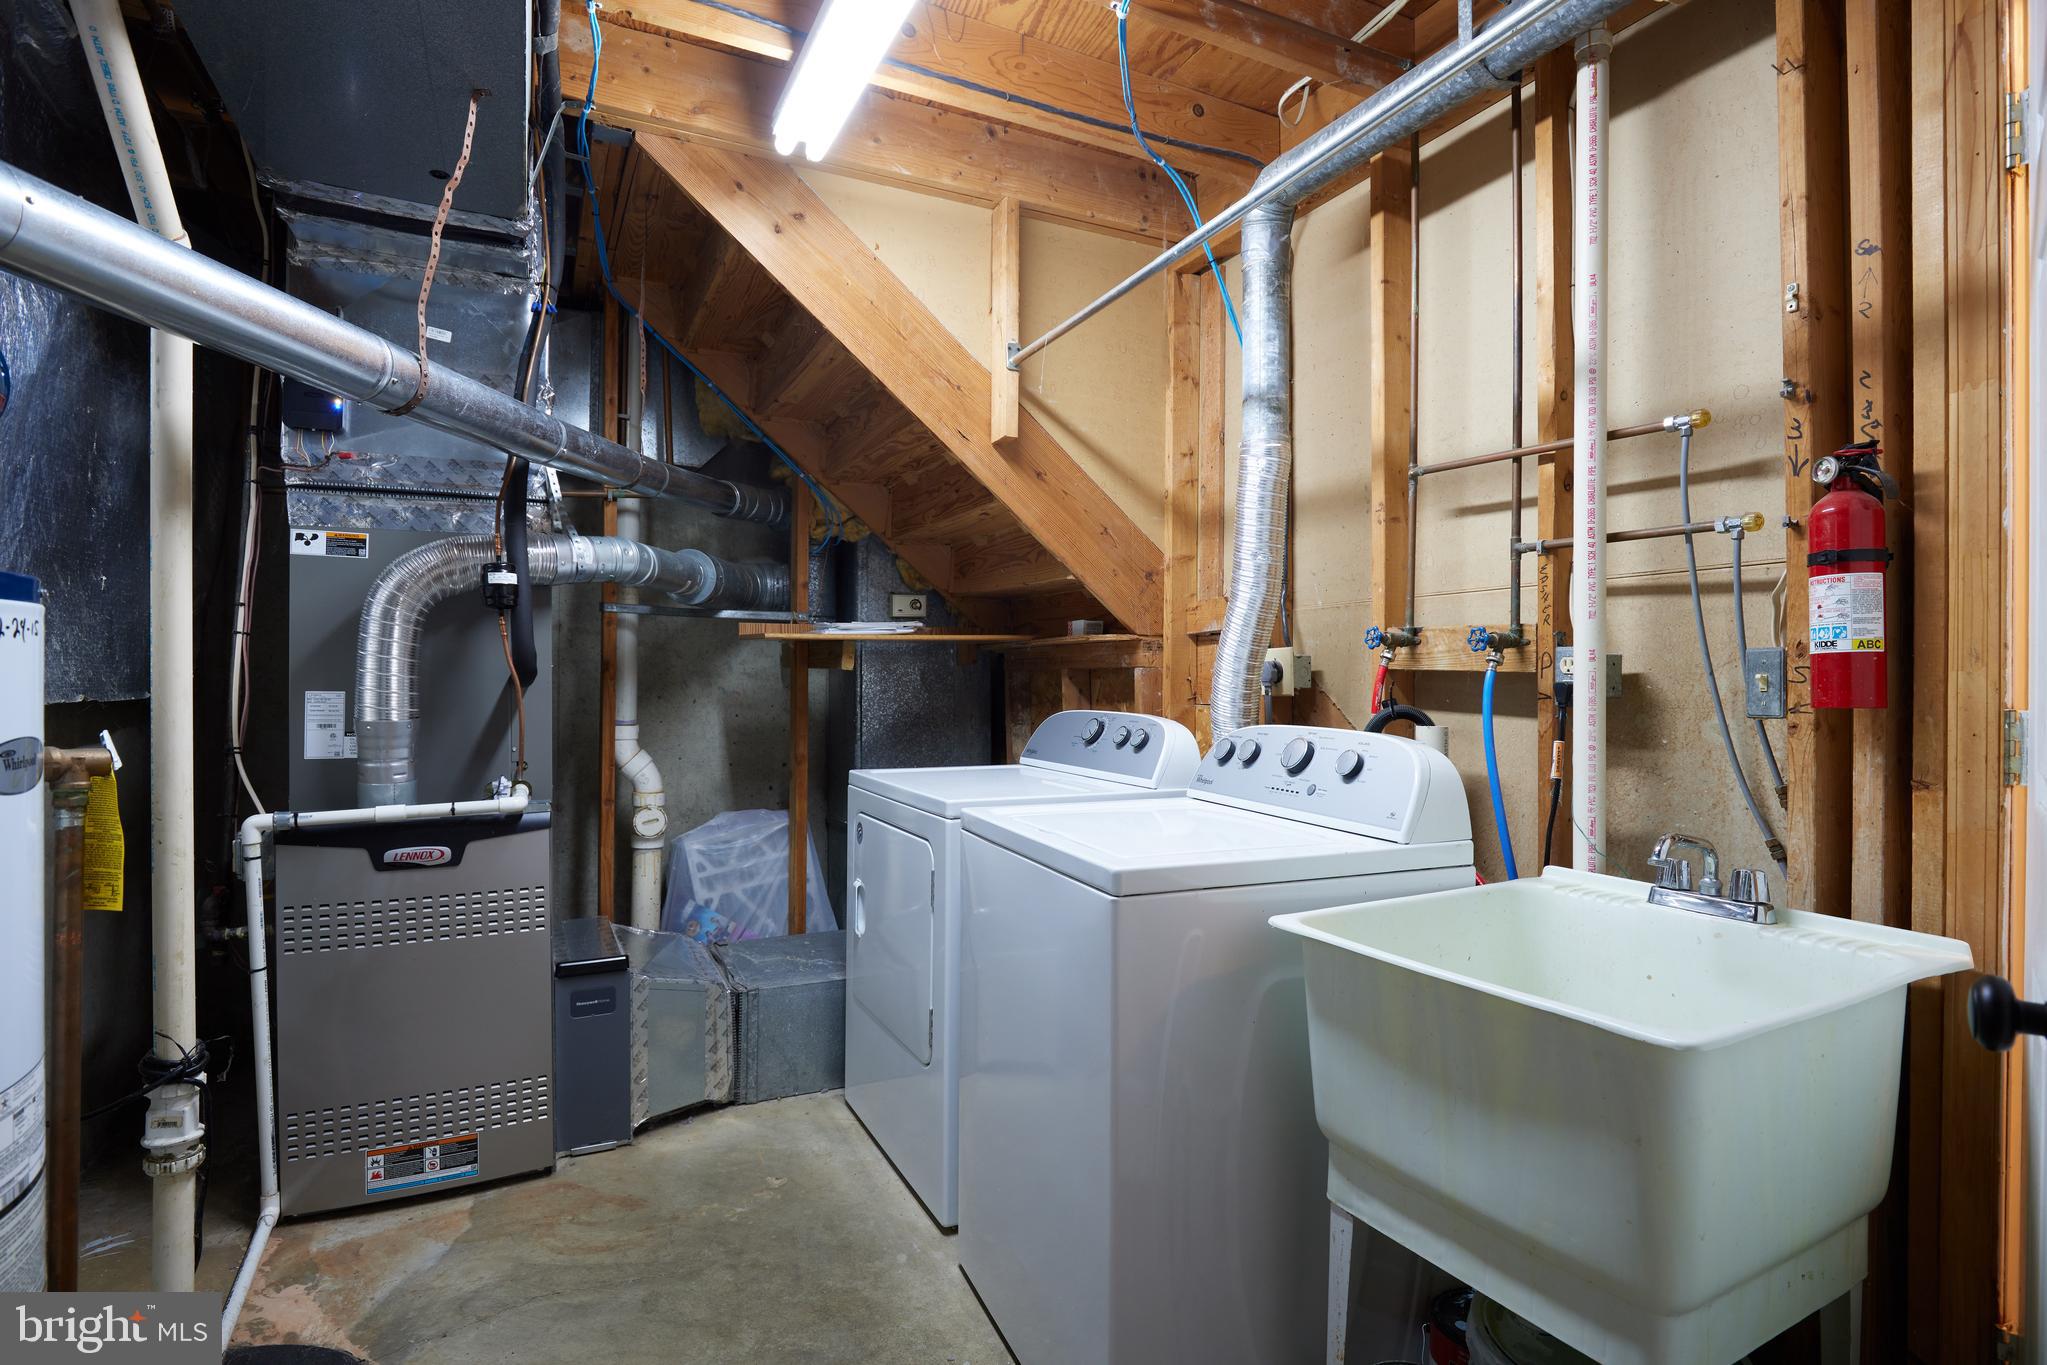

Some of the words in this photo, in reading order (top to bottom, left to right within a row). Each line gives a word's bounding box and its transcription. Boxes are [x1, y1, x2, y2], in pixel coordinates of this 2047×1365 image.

[1588, 106, 1598, 133] CHARLOTTE
[1588, 154, 1598, 167] ASTM
[1588, 176, 1598, 187] SCH
[1588, 338, 1597, 351] ASTM
[1588, 465, 1597, 477] PIPE
[1588, 478, 1597, 506] CHARLOTTE
[1588, 527, 1597, 540] ASTM
[1588, 550, 1597, 561] SCH
[1814, 640, 1838, 649] KIDDE
[1857, 639, 1881, 649] ABC
[393, 850, 434, 862] LENNOX
